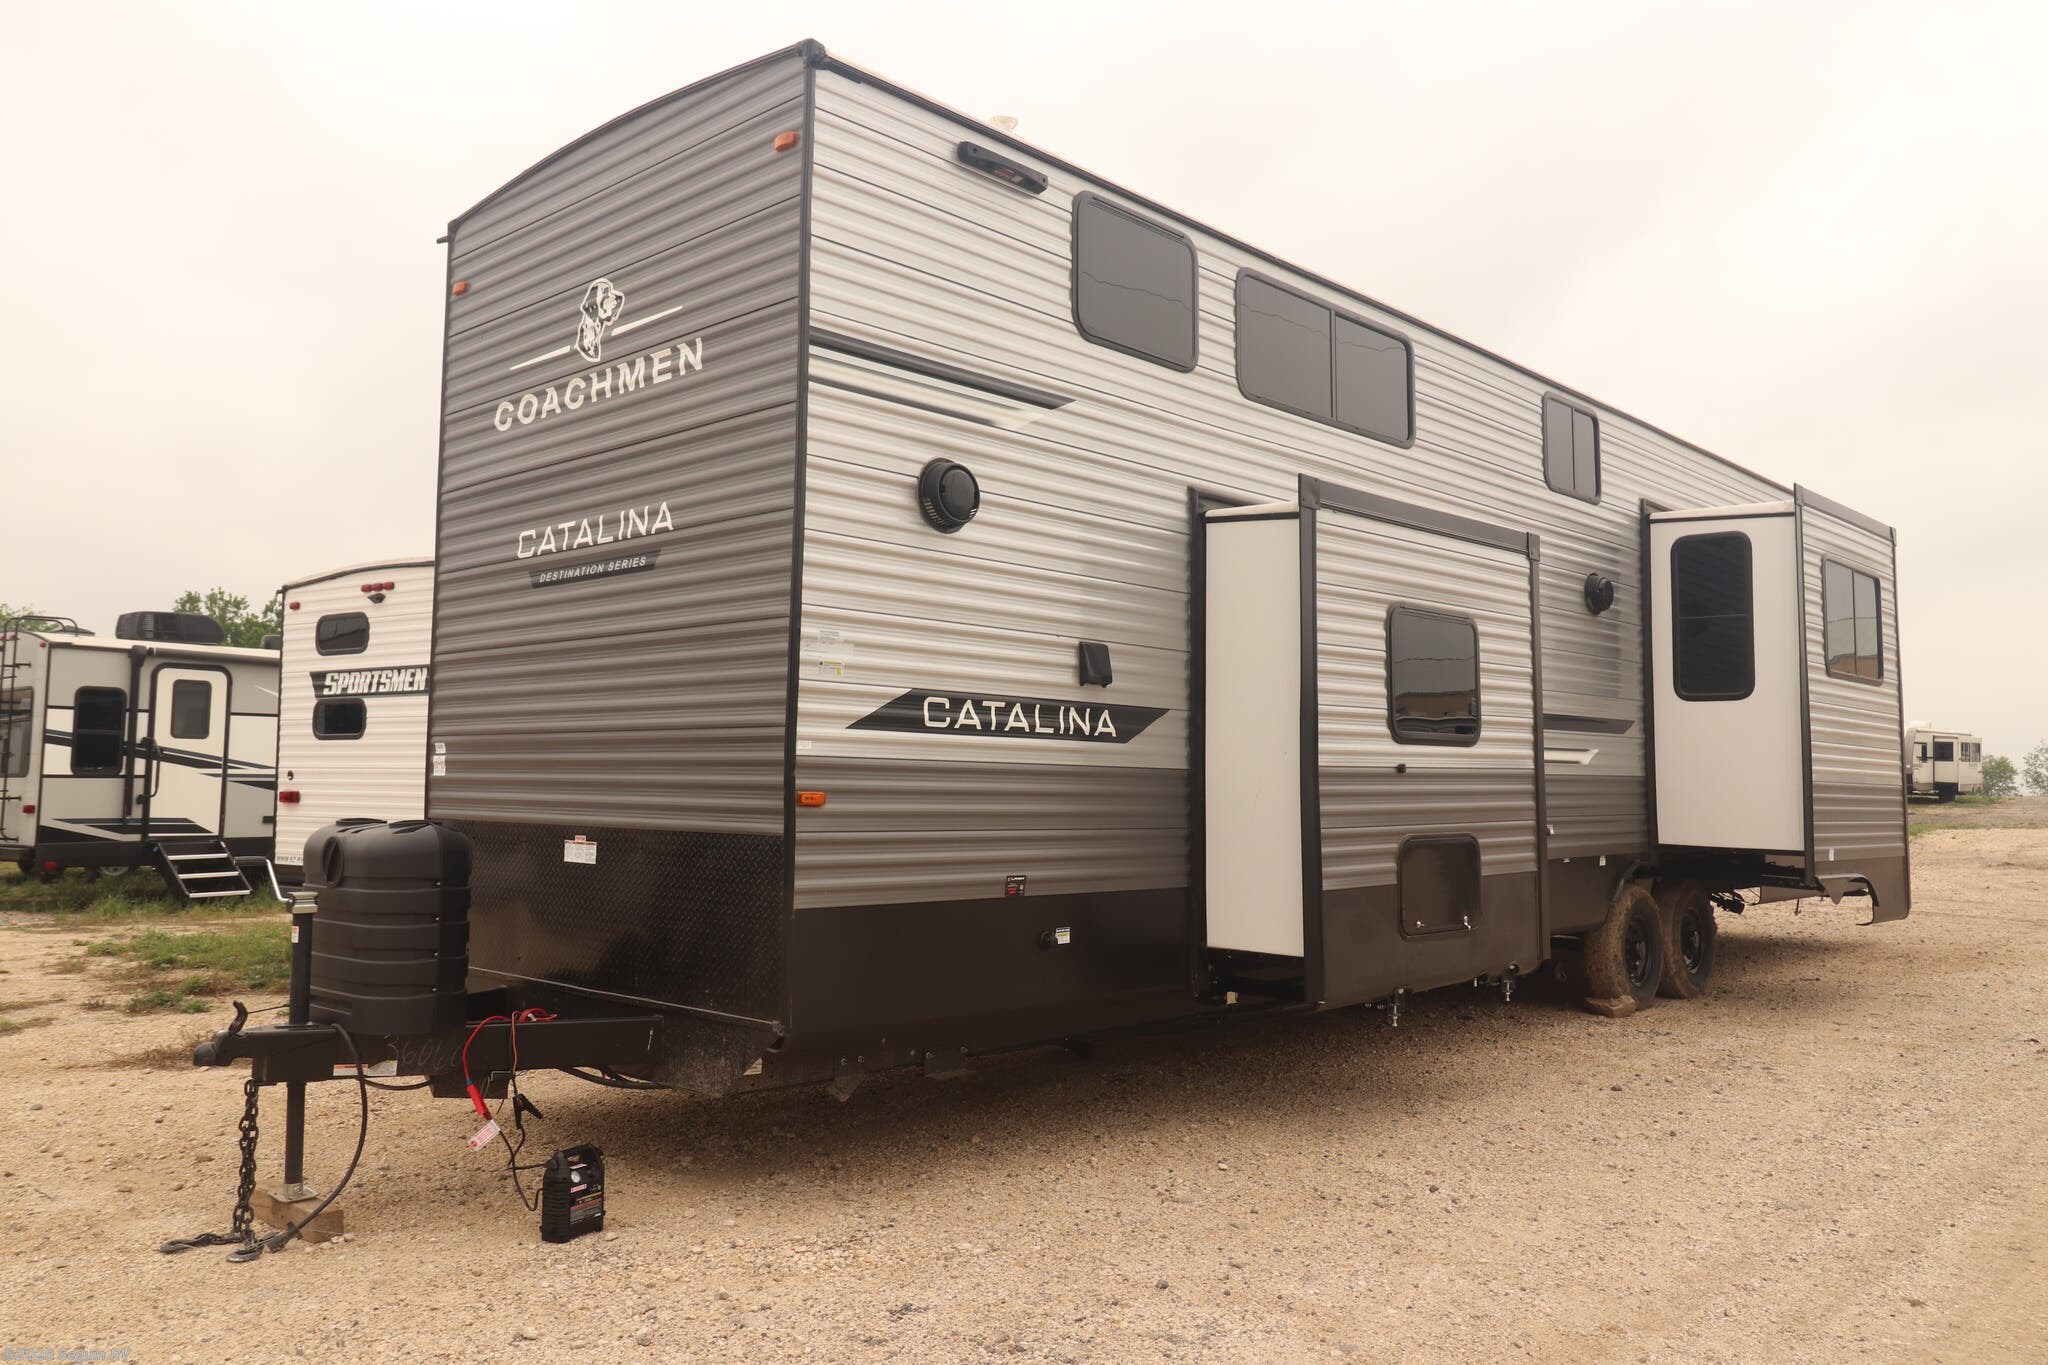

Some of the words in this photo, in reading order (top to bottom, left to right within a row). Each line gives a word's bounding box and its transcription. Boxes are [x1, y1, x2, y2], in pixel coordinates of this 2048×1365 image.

[494, 337, 704, 431] COACHMEN
[517, 501, 674, 560] CATALINA
[539, 563, 605, 583] DESTINATION
[608, 556, 647, 573] SERIES
[323, 667, 428, 695] SPORTSMEN
[923, 696, 1117, 737] CATALINA
